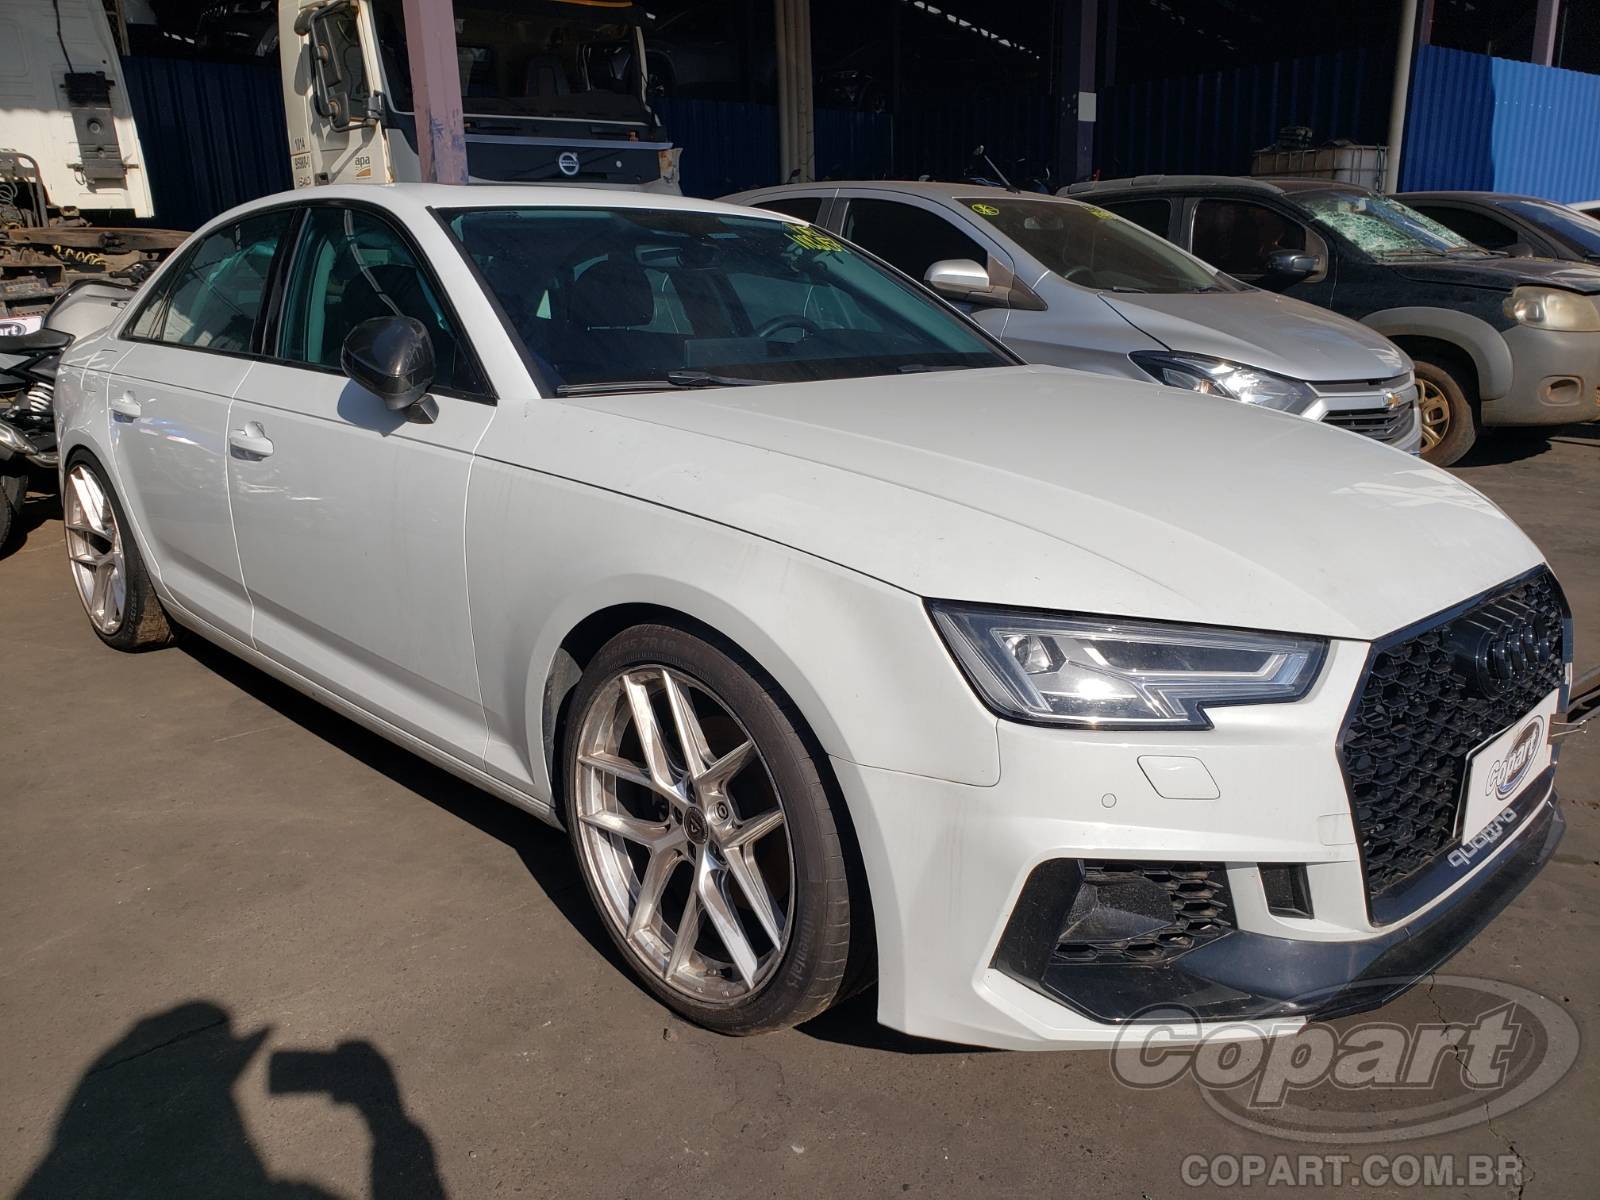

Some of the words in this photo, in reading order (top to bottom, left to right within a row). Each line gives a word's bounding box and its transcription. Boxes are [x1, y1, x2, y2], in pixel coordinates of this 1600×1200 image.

[355, 155, 371, 168] apa
[1486, 728, 1540, 796] Copart
[1447, 807, 1518, 868] quattro
